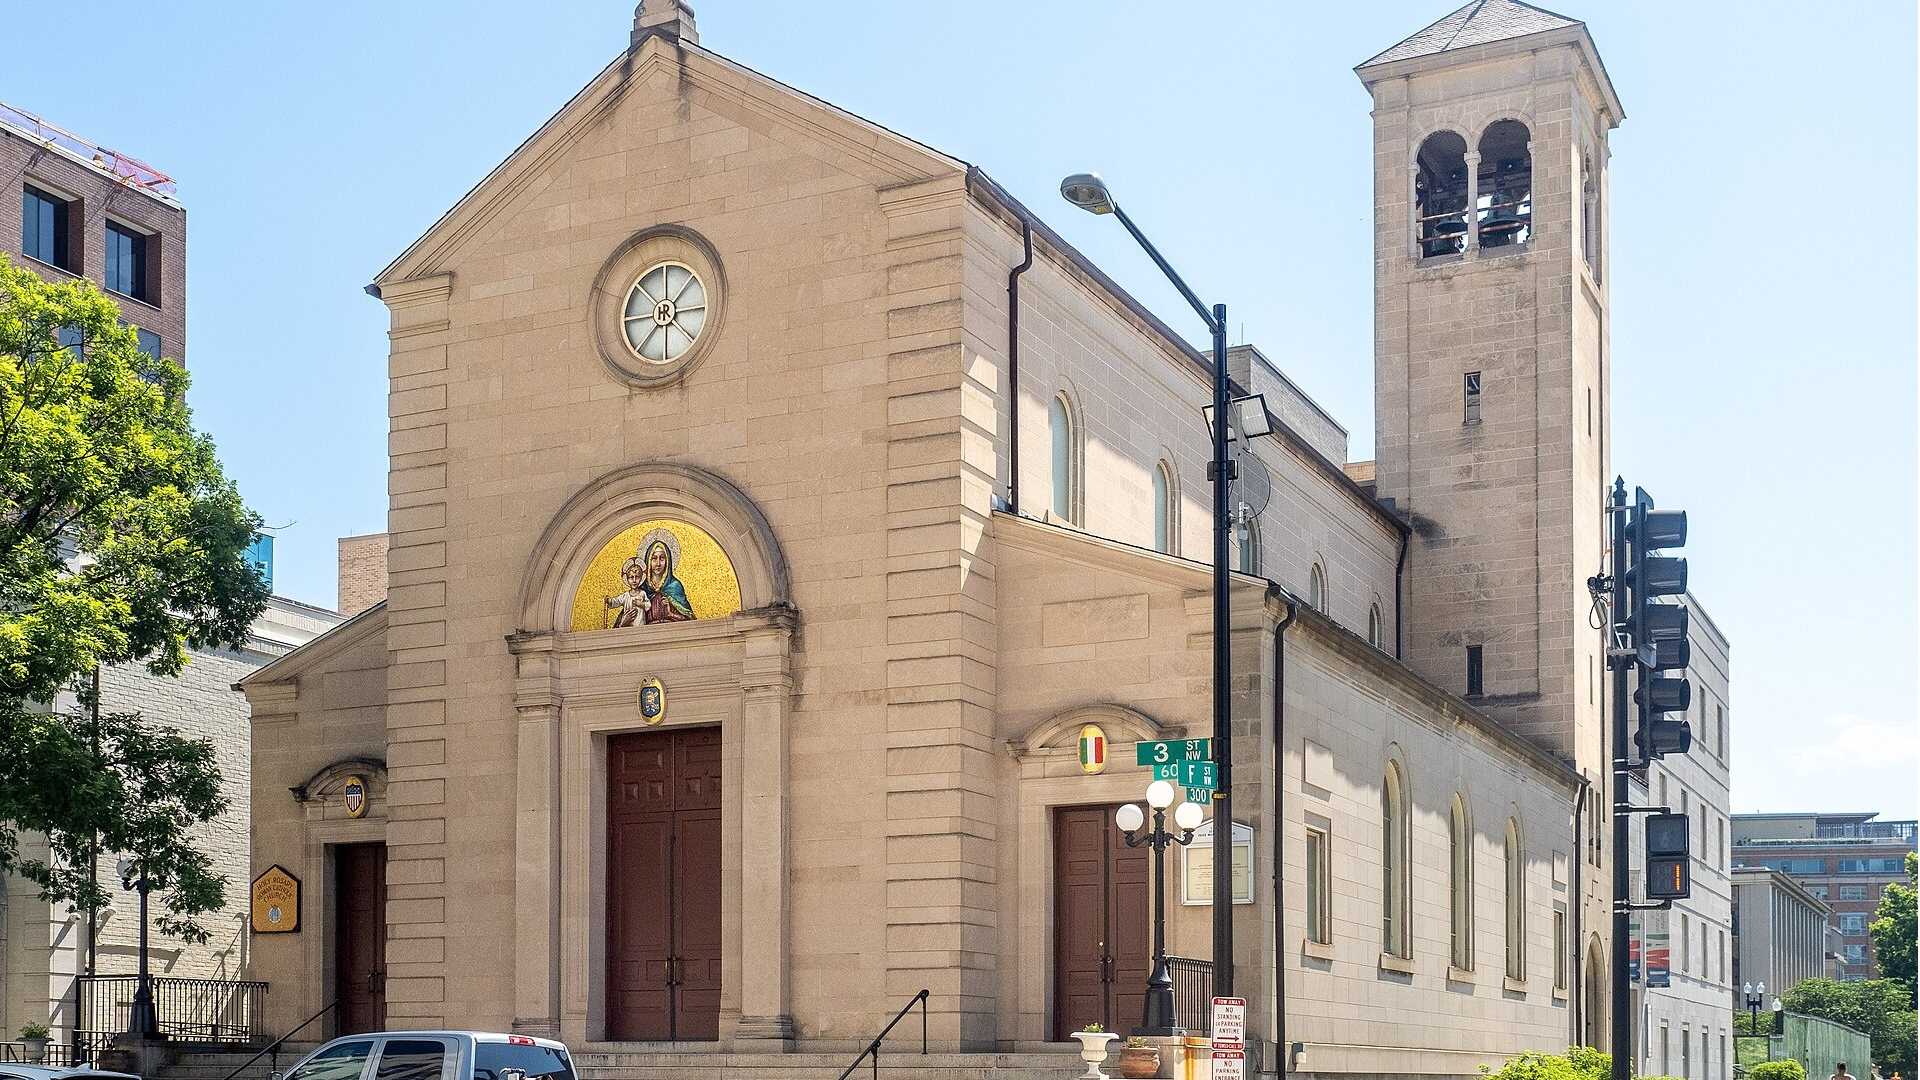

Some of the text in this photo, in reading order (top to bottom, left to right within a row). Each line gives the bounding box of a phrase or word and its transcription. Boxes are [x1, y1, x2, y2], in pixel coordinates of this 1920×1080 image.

[1154, 740, 1200, 762] 3 ST
[1185, 751, 1201, 760] NW
[1160, 763, 1178, 778] 60
[1188, 764, 1211, 784] F ST
[1203, 776, 1212, 786] NW
[1190, 788, 1207, 803] 300
